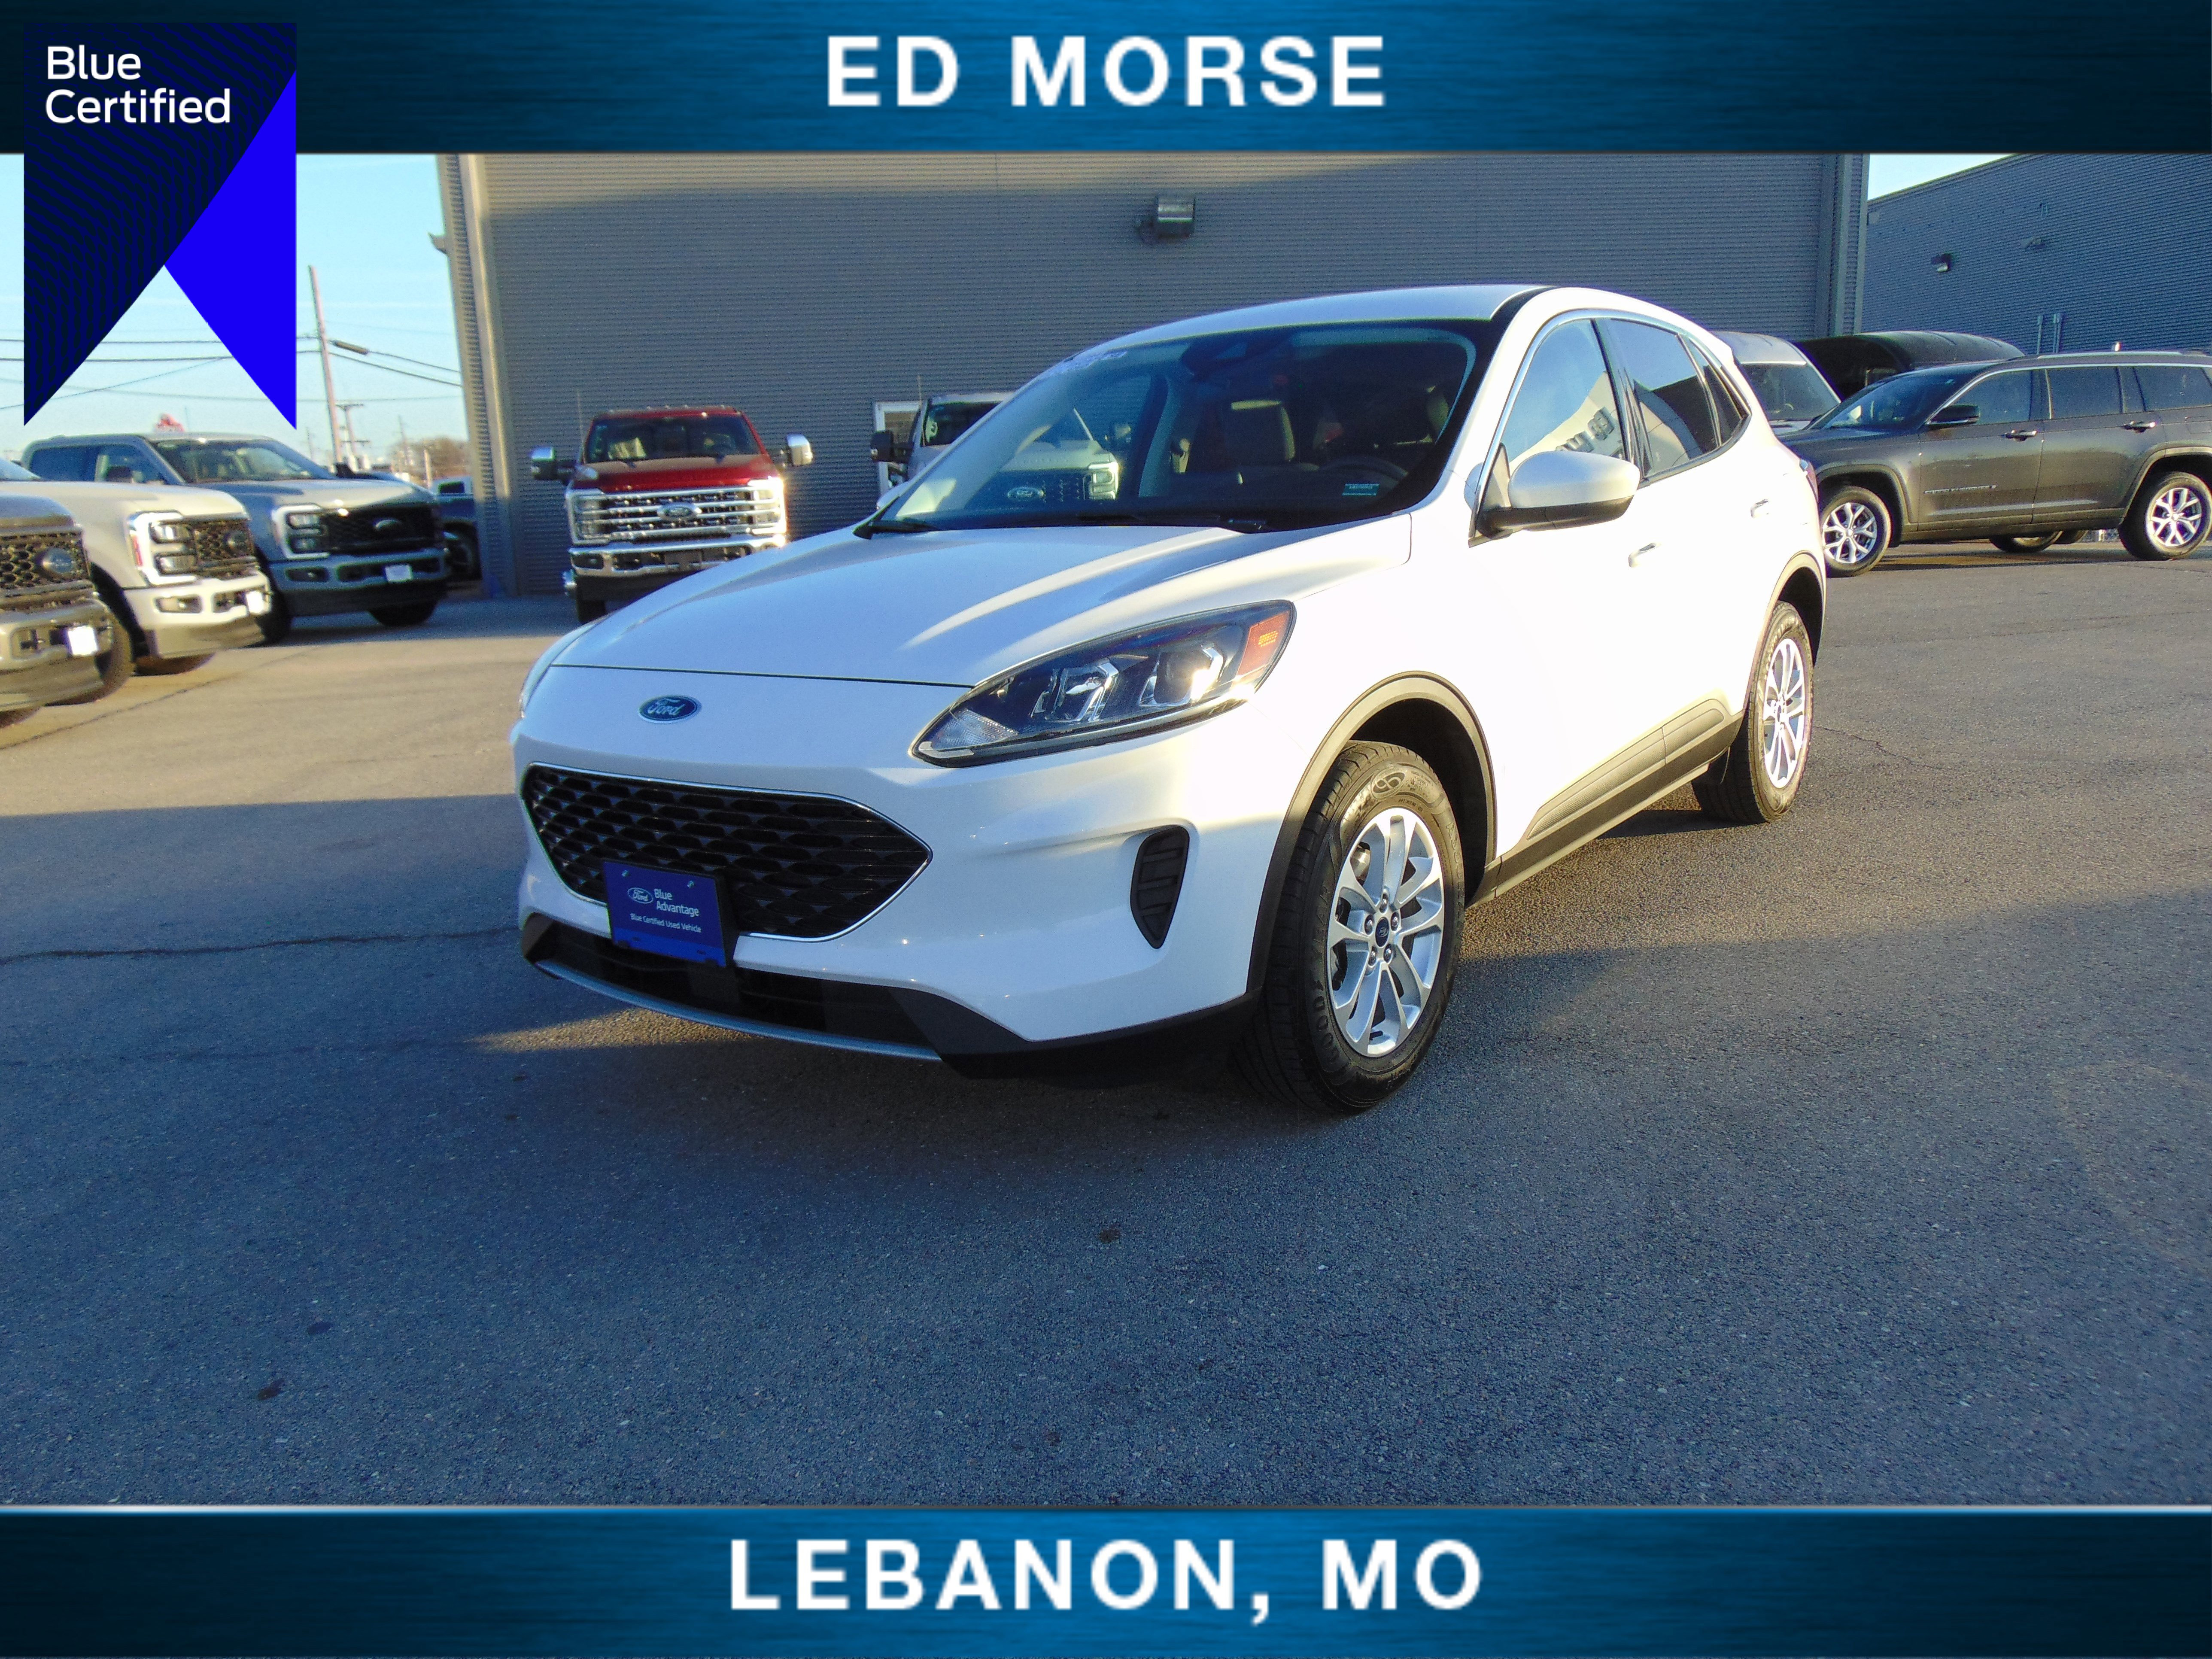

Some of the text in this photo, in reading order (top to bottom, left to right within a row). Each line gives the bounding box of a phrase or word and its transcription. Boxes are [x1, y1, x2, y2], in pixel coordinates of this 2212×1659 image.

[647, 698, 686, 716] Ford
[632, 889, 649, 902] Ford
[654, 888, 673, 900] Blue
[656, 900, 700, 918] Advantage
[630, 913, 702, 933] Blue Certified Used Vehicle
